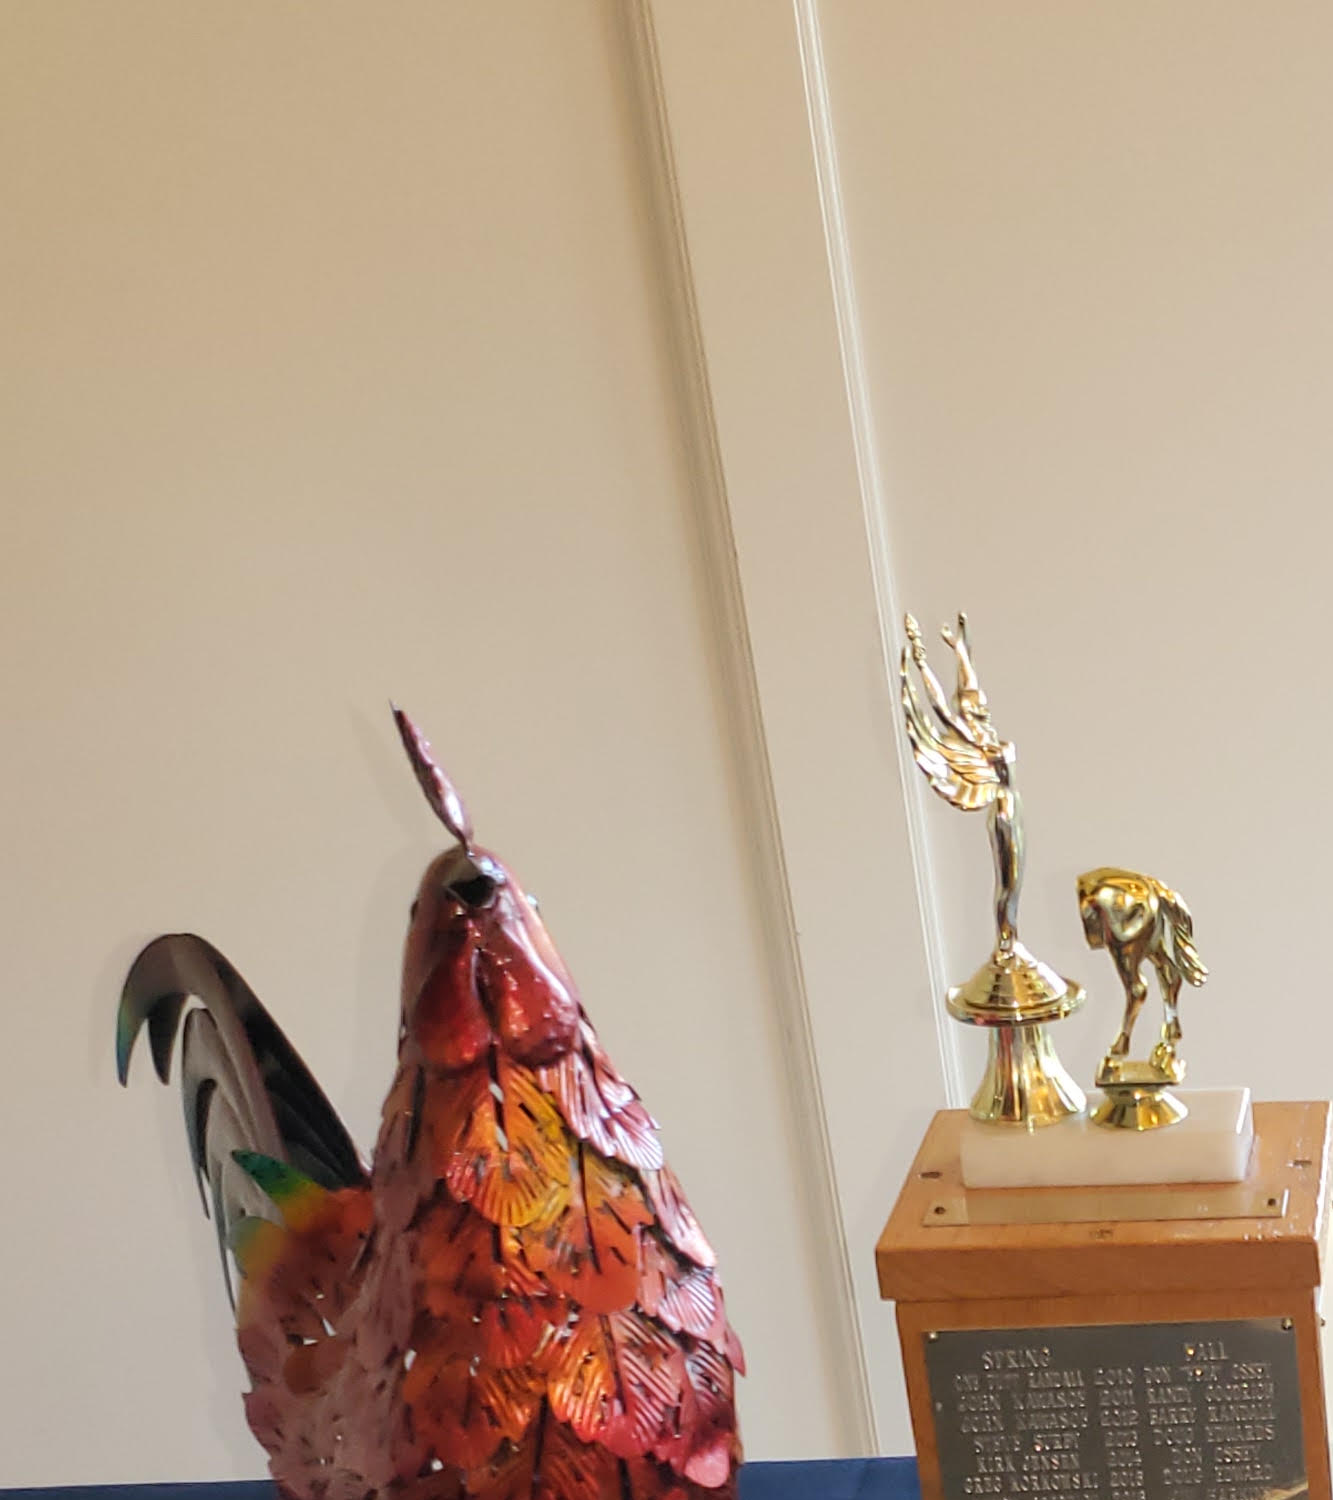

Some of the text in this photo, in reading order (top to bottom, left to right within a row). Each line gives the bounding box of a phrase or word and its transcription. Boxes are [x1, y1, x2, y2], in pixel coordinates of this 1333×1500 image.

[982, 1349, 1050, 1369] SPRING
[1184, 1342, 1230, 1362] FALL
[1097, 1388, 1134, 1407] 2011
[1100, 1408, 1139, 1426] 2012
